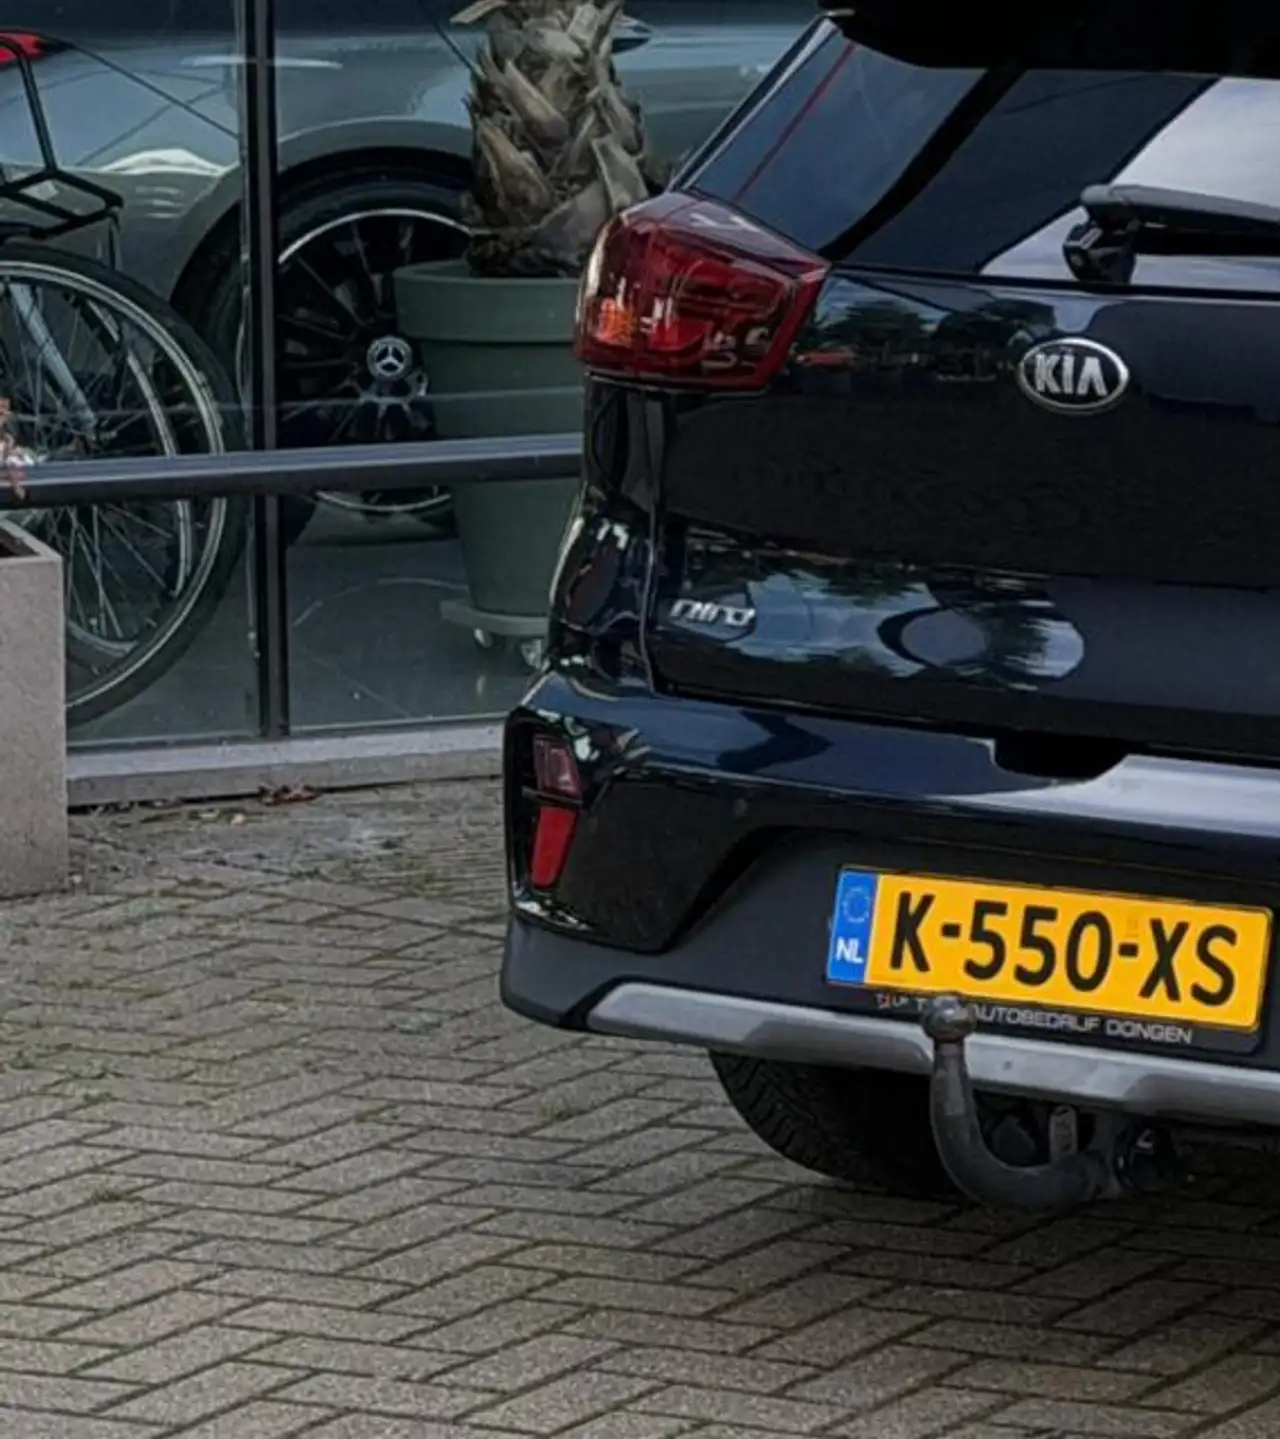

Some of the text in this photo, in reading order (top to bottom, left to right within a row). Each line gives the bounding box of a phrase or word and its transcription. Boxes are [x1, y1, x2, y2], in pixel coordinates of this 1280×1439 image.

[1034, 353, 1108, 397] KIA
[834, 890, 1238, 1007] NL K-550-XS
[1106, 1019, 1193, 1045] DONGEN
